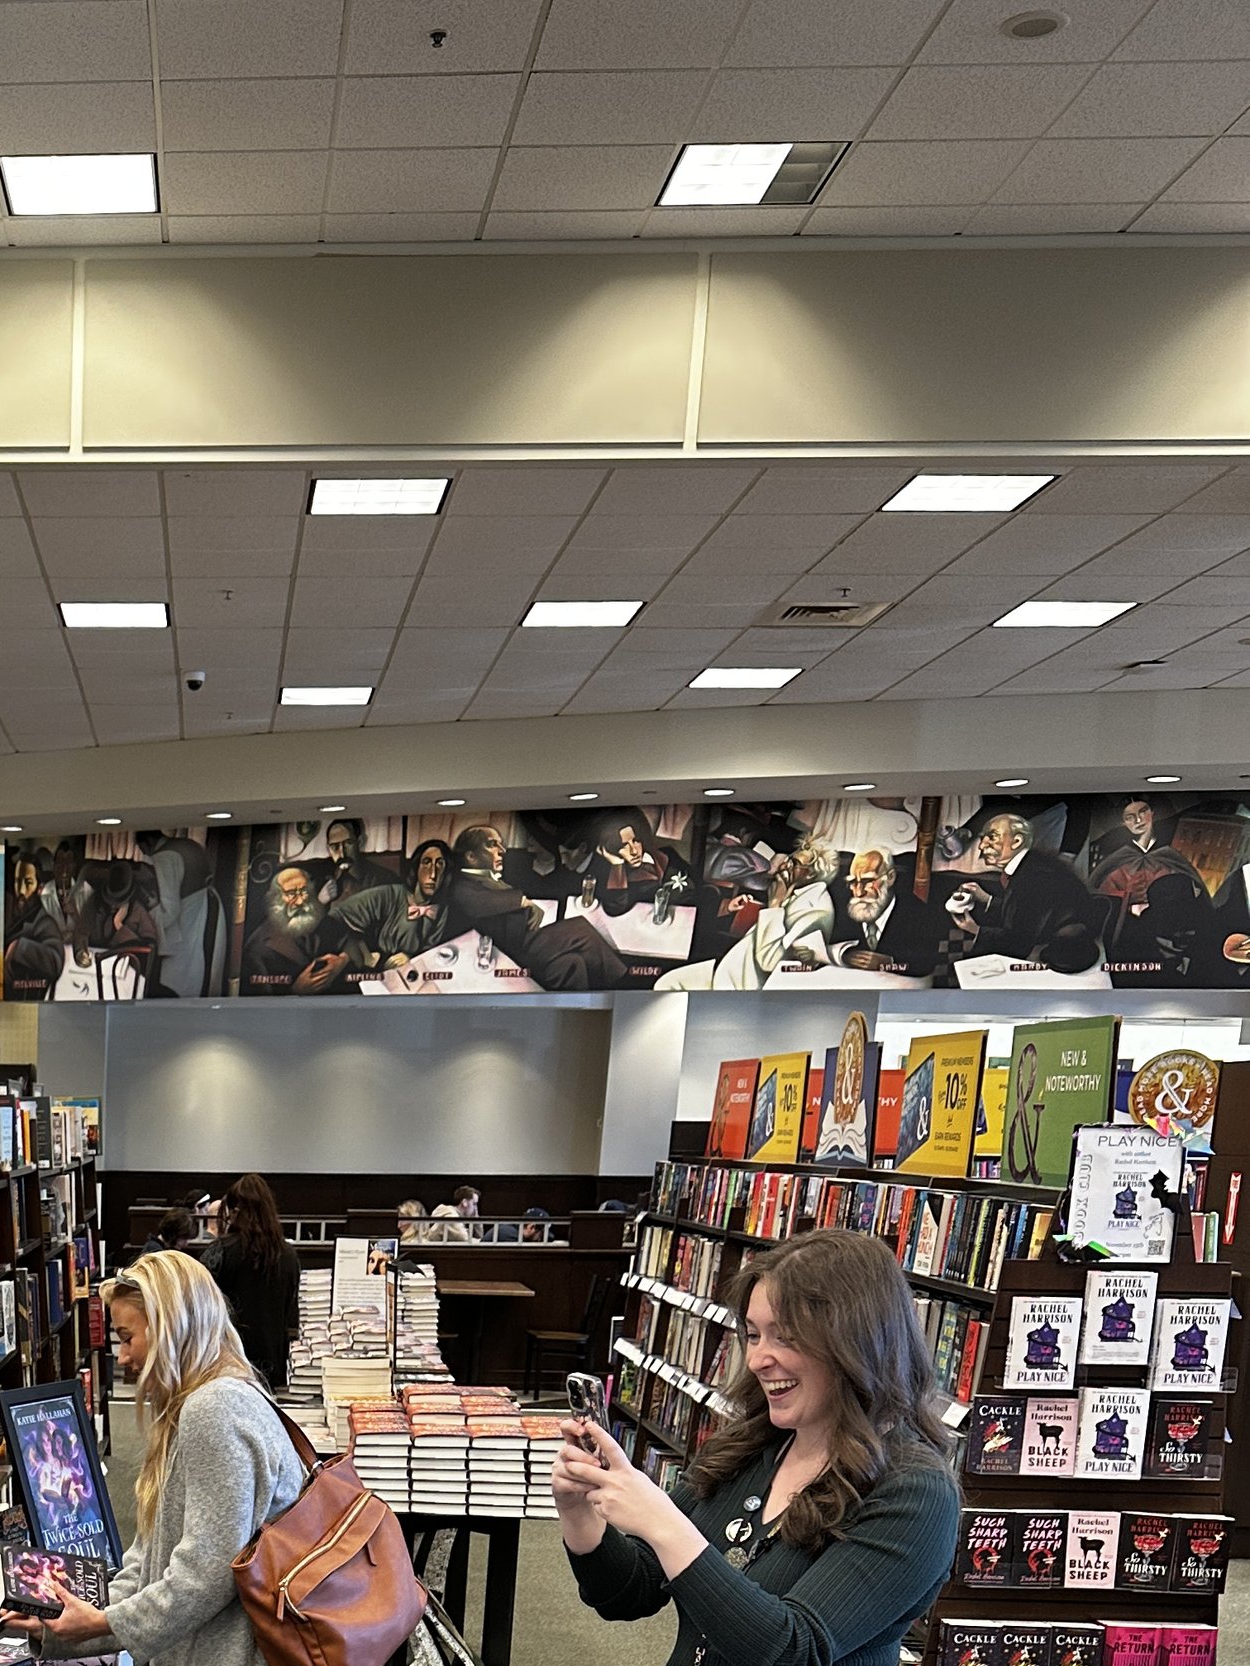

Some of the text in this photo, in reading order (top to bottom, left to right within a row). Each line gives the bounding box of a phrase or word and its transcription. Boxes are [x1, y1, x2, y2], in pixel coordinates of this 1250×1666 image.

[630, 967, 659, 976] WILDE
[879, 963, 908, 972] SHAW
[1103, 962, 1162, 972] DICKINSON
[424, 972, 452, 980] ELIOT
[496, 970, 528, 978] JAMES
[13, 978, 47, 989] MELVILLE
[1061, 1050, 1087, 1067] NEW &
[1045, 1074, 1102, 1092] NOTEWORTHY
[946, 1072, 968, 1110] 10%
[1154, 1070, 1194, 1114] &
[1098, 1136, 1178, 1148] PLAY NICE
[1078, 1154, 1092, 1192] CLUB
[1108, 1220, 1140, 1229] PLAY NICE
[1105, 1278, 1143, 1288] RACHEL
[1098, 1288, 1148, 1298] HARRISON
[1030, 1304, 1068, 1314] RACHEL
[1178, 1305, 1216, 1315] RACHEL
[1023, 1314, 1073, 1324] HARRISON
[1170, 1315, 1220, 1326] HARRISON
[1017, 1372, 1066, 1382] PLAY NICE
[1164, 1374, 1213, 1384] PLAY NICE
[1098, 1394, 1136, 1404] RACHEL
[978, 1406, 1022, 1417] CACKLE
[1036, 1404, 1068, 1412] Rachel
[1092, 1404, 1141, 1414] HARRISON
[16, 1408, 72, 1426] KATIE HALLAHAN
[1030, 1412, 1072, 1422] Harrison
[1028, 1446, 1068, 1456] BLACK
[1160, 1442, 1176, 1453] So
[1028, 1457, 1066, 1468] SHEEP
[1158, 1452, 1202, 1464] THIRSTY
[1085, 1461, 1134, 1472] PLAY NICE
[63, 1513, 78, 1524] THE
[974, 1516, 1006, 1527] SUCH
[1028, 1517, 1060, 1529] SUCH
[1078, 1517, 1110, 1526] Rachel
[1136, 1517, 1167, 1526] RACHEL
[1072, 1526, 1114, 1536] Harrison
[1192, 1522, 1224, 1531] RACHEL
[42, 1518, 104, 1548] TWICE-SOLD
[968, 1527, 1007, 1540] SHARP
[1022, 1529, 1062, 1542] SHARP
[58, 1538, 101, 1558] SOUL
[968, 1537, 1006, 1551] TEETH
[1022, 1539, 1061, 1553] TEETH
[1125, 1552, 1141, 1564] So
[1182, 1556, 1196, 1568] So
[1069, 1558, 1110, 1570] BLACK
[1124, 1562, 1168, 1576] THIRSTY
[1069, 1570, 1108, 1580] SHEEP
[1180, 1566, 1224, 1580] THIRSTY
[954, 1632, 997, 1644] CACKLE
[1004, 1632, 1046, 1645] CACKLE
[1056, 1634, 1098, 1646] CACKLE
[1128, 1634, 1142, 1642] THE
[1184, 1634, 1198, 1644] THE
[1114, 1642, 1154, 1654] RETURN
[1170, 1642, 1210, 1656] RETURN
